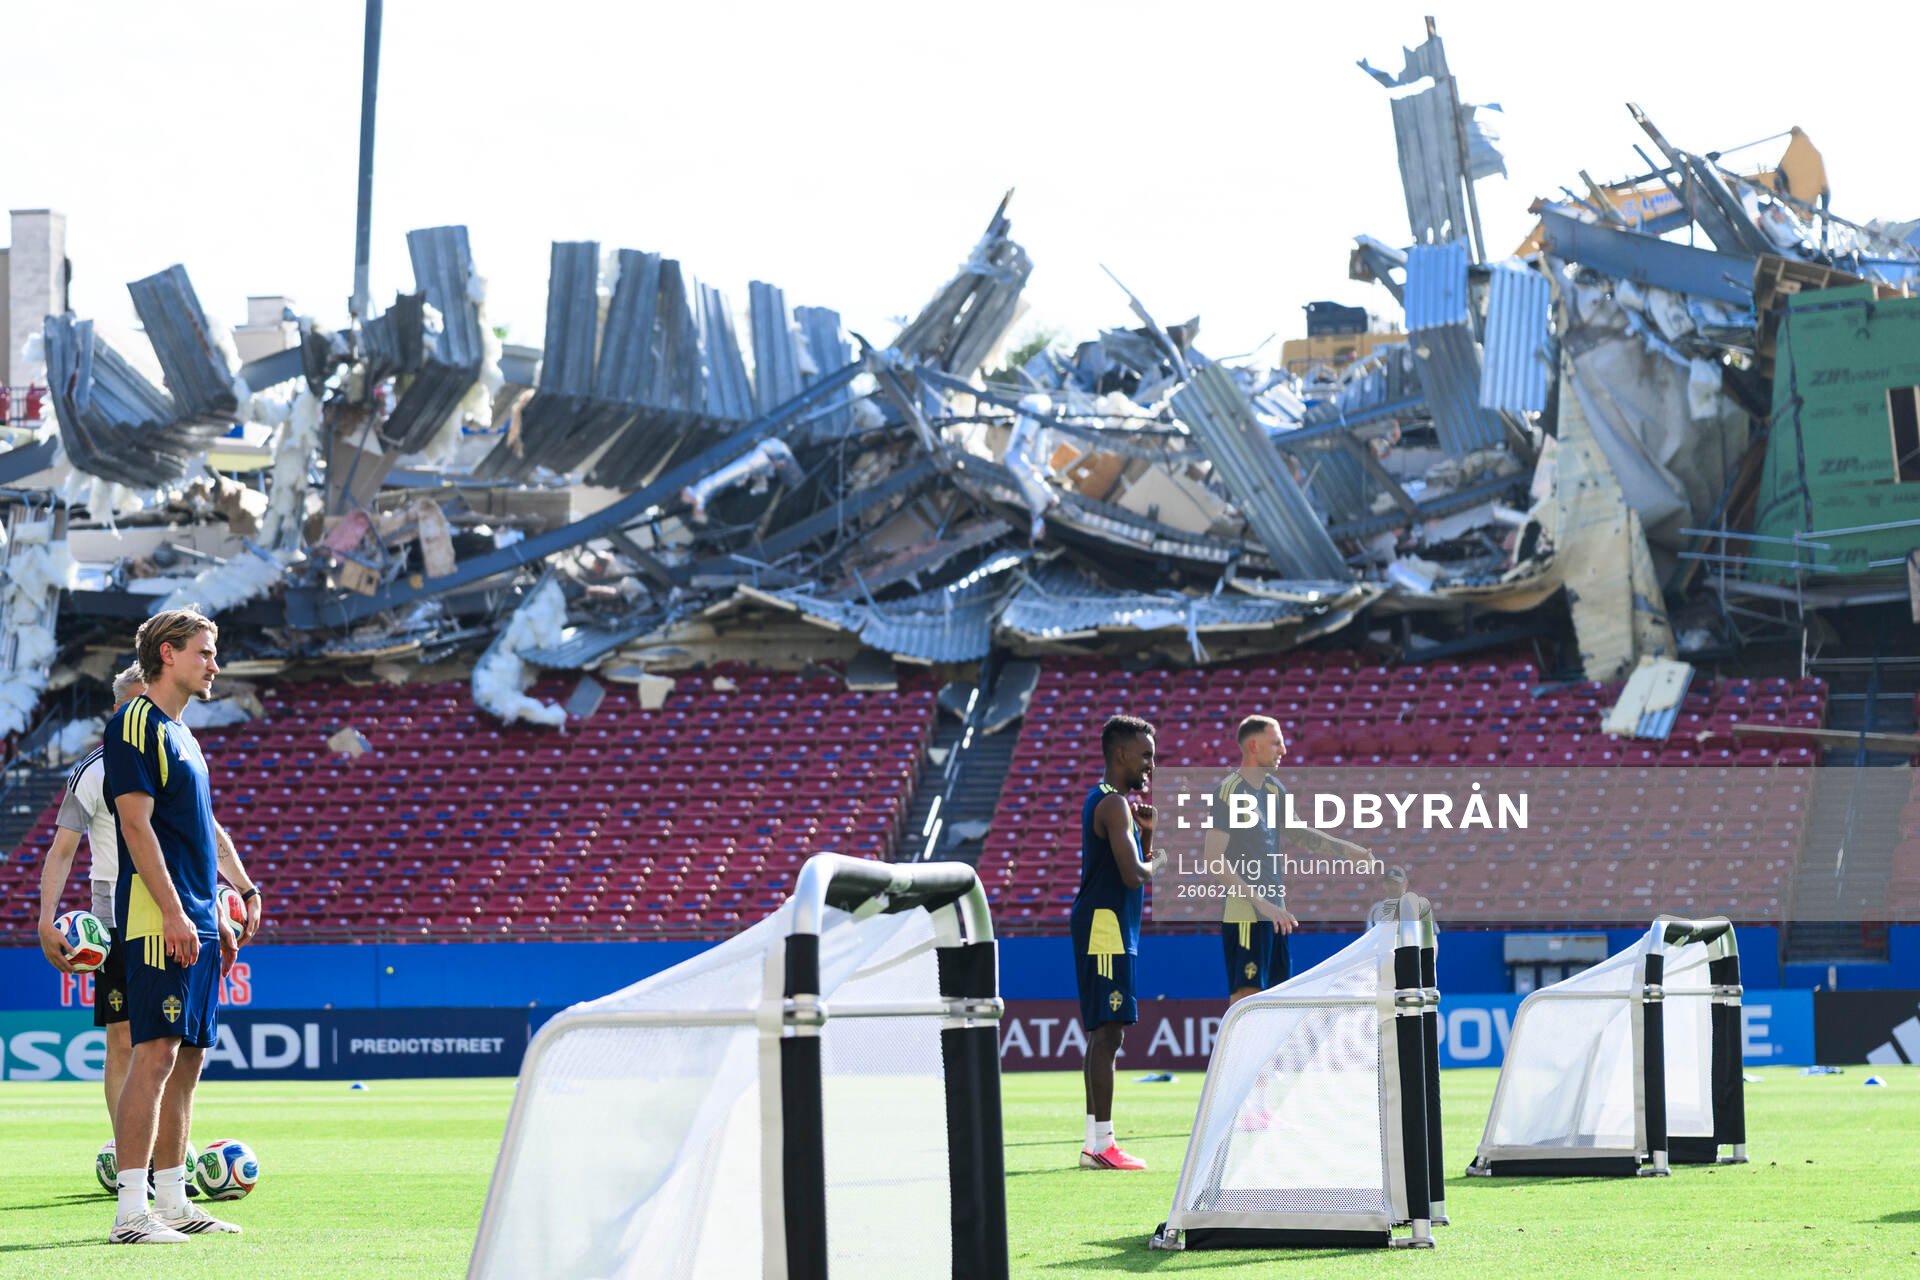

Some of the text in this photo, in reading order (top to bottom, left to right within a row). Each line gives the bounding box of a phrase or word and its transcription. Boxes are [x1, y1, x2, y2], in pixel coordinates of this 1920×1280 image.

[0, 1029, 107, 1081] se
[350, 1037, 504, 1054] PREDICTSTREET
[1000, 1016, 1222, 1058] ATA AIR
